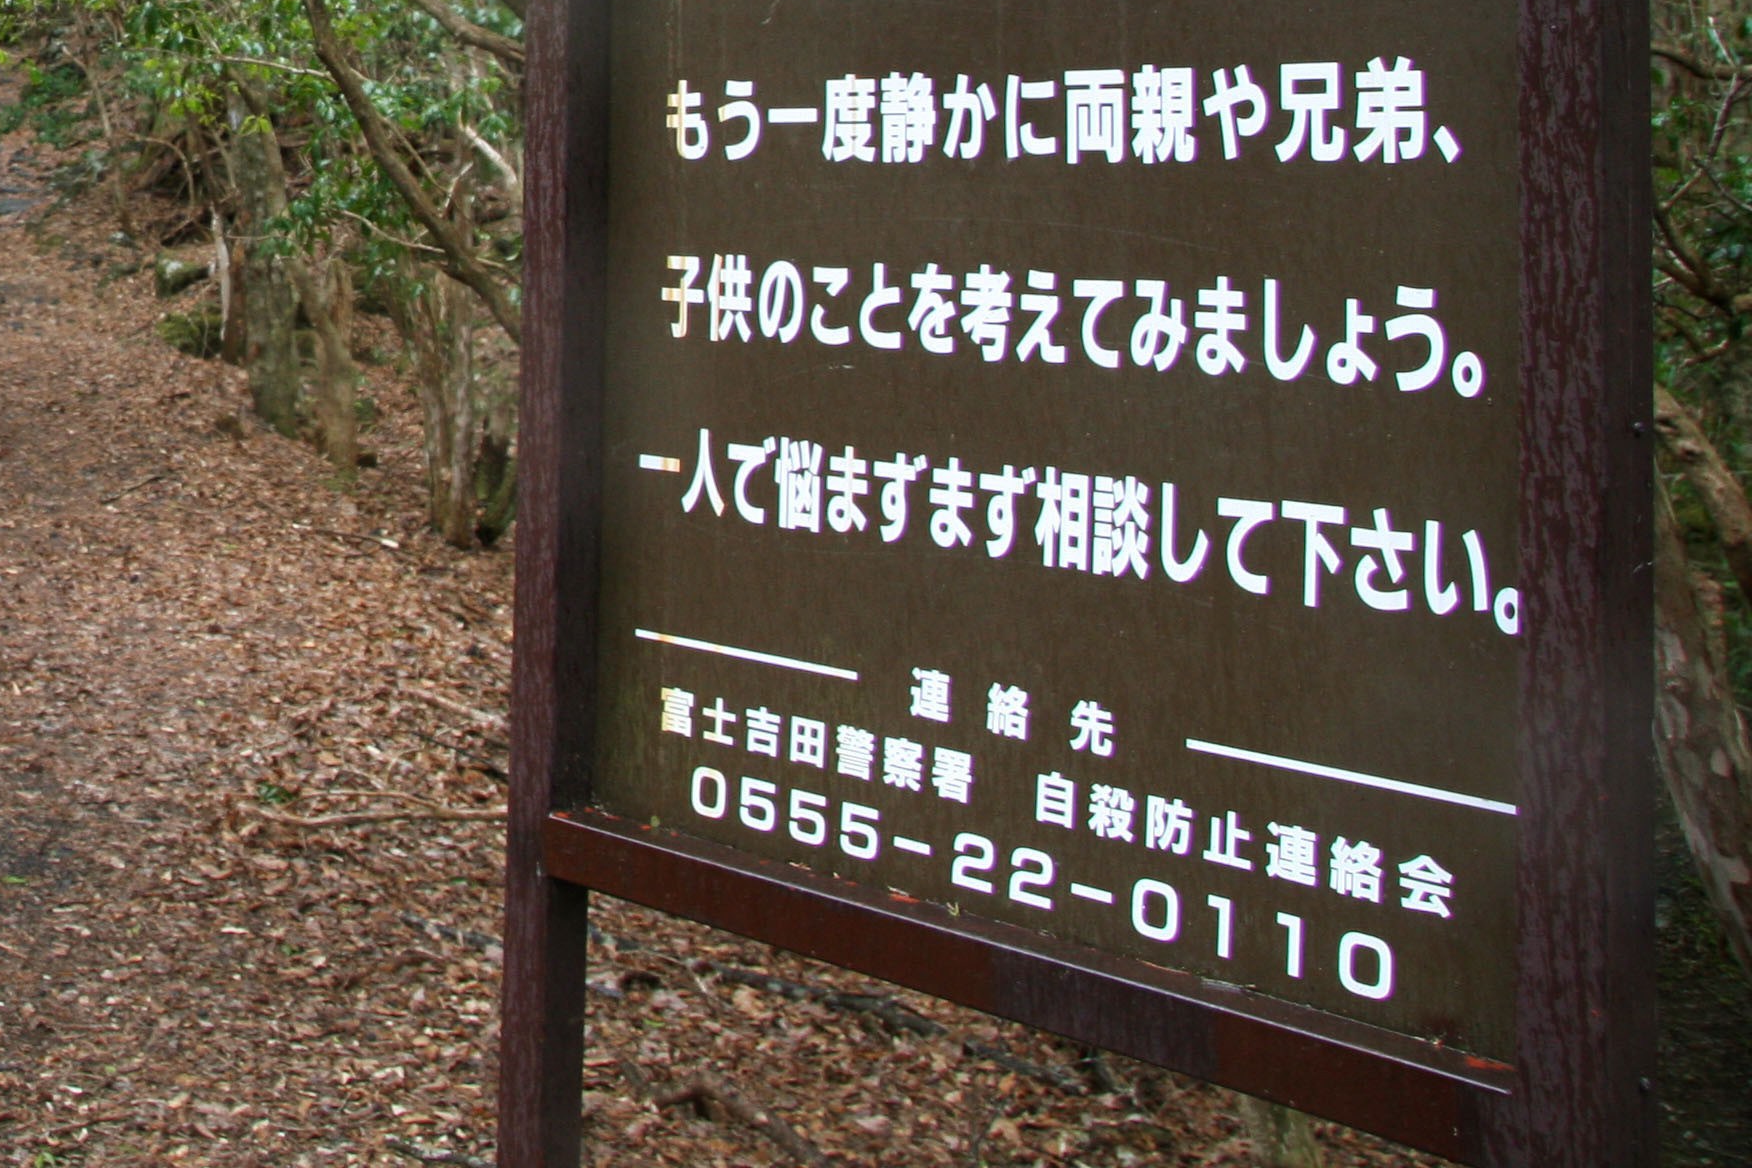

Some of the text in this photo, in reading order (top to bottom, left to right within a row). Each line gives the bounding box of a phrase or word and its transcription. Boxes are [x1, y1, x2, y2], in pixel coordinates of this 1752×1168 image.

[666, 55, 1460, 165] もう一度静かに両親や兄弟、
[661, 253, 1483, 399] 子供のことを考えてみましょう。
[638, 428, 1519, 635] 一人で悩まずまず相談して下さい。
[660, 687, 1454, 920] 富士吉田警察署 自殺防止連絡会
[690, 766, 1394, 1001] 0555-22-0110
